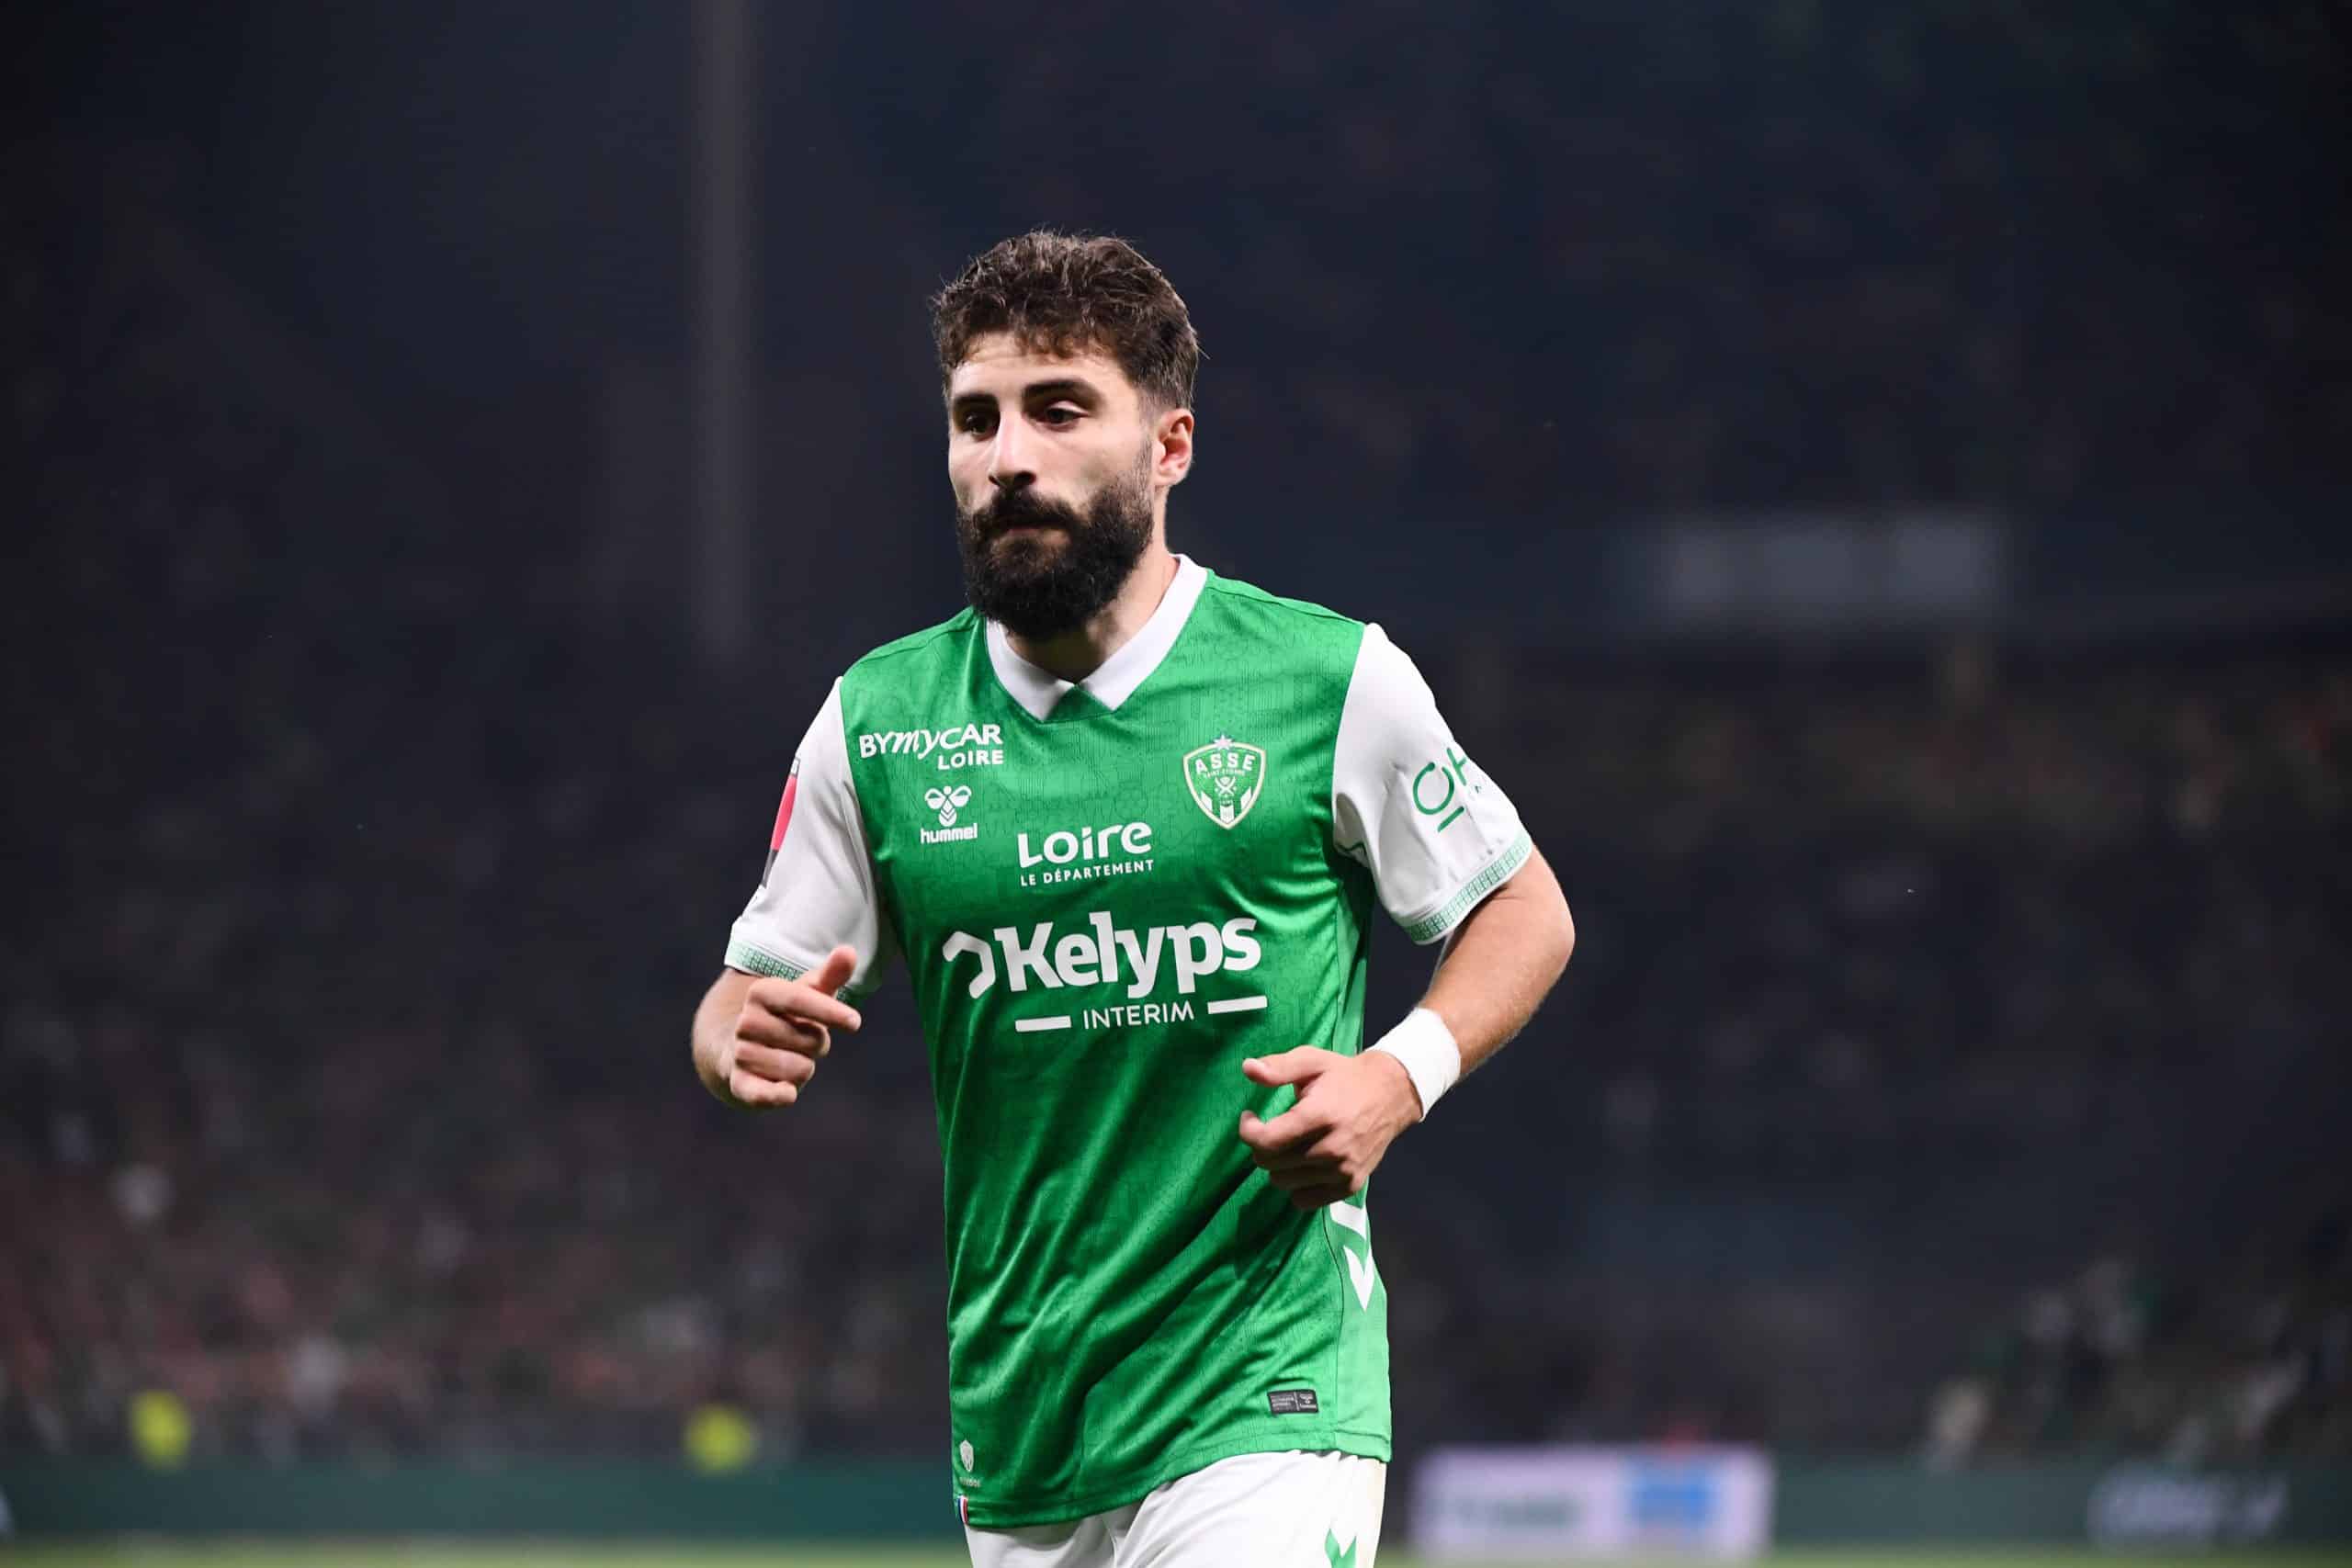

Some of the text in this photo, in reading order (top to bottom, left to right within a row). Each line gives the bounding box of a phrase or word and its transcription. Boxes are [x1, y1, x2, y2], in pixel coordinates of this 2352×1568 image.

[937, 750, 1004, 770] LOIRE
[1194, 751, 1257, 775] ASSE
[920, 822, 978, 844] hummel
[1017, 821, 1152, 868] Loire
[1020, 859, 1154, 886] LE DÉPARTEMENT
[993, 910, 1261, 999] Kelyps
[1083, 1000, 1194, 1030] INTERIM
